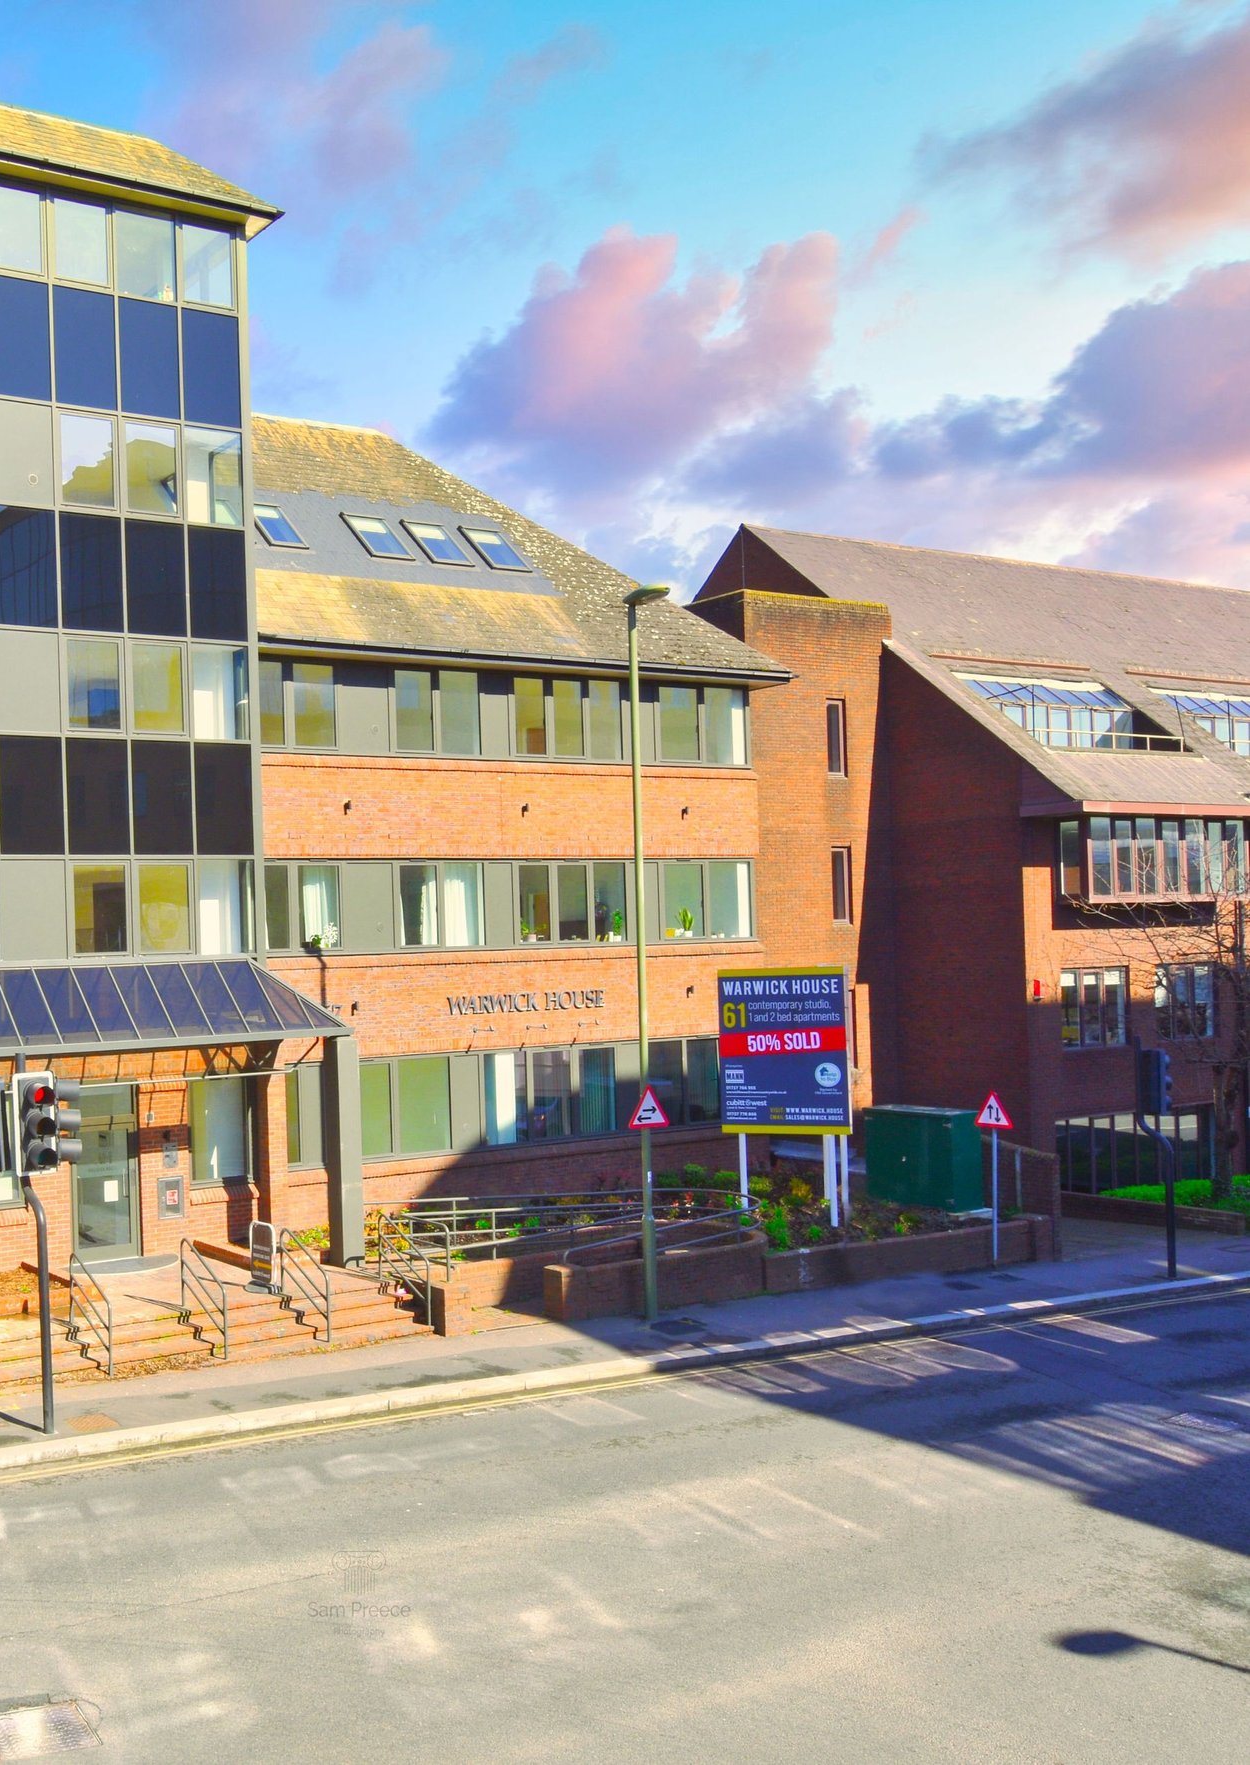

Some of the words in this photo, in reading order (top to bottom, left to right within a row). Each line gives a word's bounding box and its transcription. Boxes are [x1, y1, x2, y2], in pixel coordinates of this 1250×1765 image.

[722, 980, 789, 996] WARWICK
[792, 978, 839, 994] HOUSE
[447, 993, 541, 1016] WARWICK
[545, 989, 607, 1011] HOUSE
[748, 1000, 803, 1011] contemporary
[723, 1002, 748, 1028] 61
[749, 1013, 753, 1022] 1
[754, 1013, 769, 1022] and
[770, 1012, 775, 1021] 2
[776, 1012, 792, 1021] bed
[793, 1011, 840, 1023] apartments
[747, 1034, 781, 1052] 50%
[784, 1032, 821, 1050] SOLD
